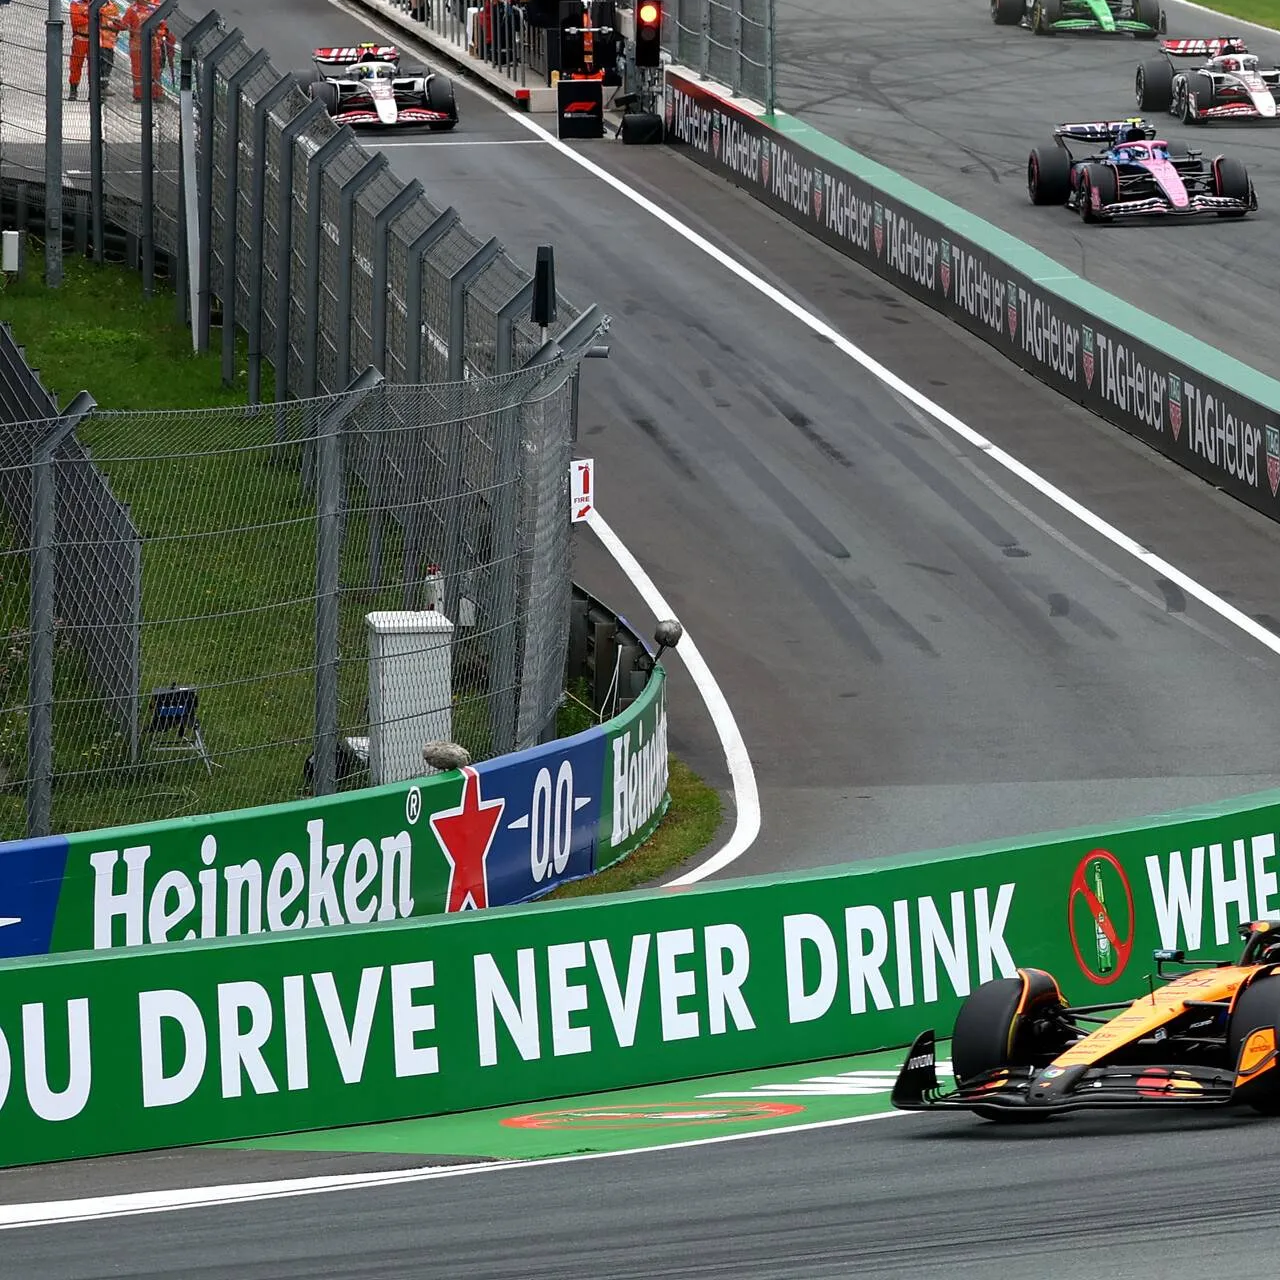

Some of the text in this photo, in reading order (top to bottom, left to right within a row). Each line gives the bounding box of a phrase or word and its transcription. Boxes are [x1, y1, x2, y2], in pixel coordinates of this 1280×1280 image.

[90, 820, 415, 949] Heineken
[530, 760, 575, 884] 0.0
[0, 883, 1019, 1121] U DRIVE NEVER DRINK
